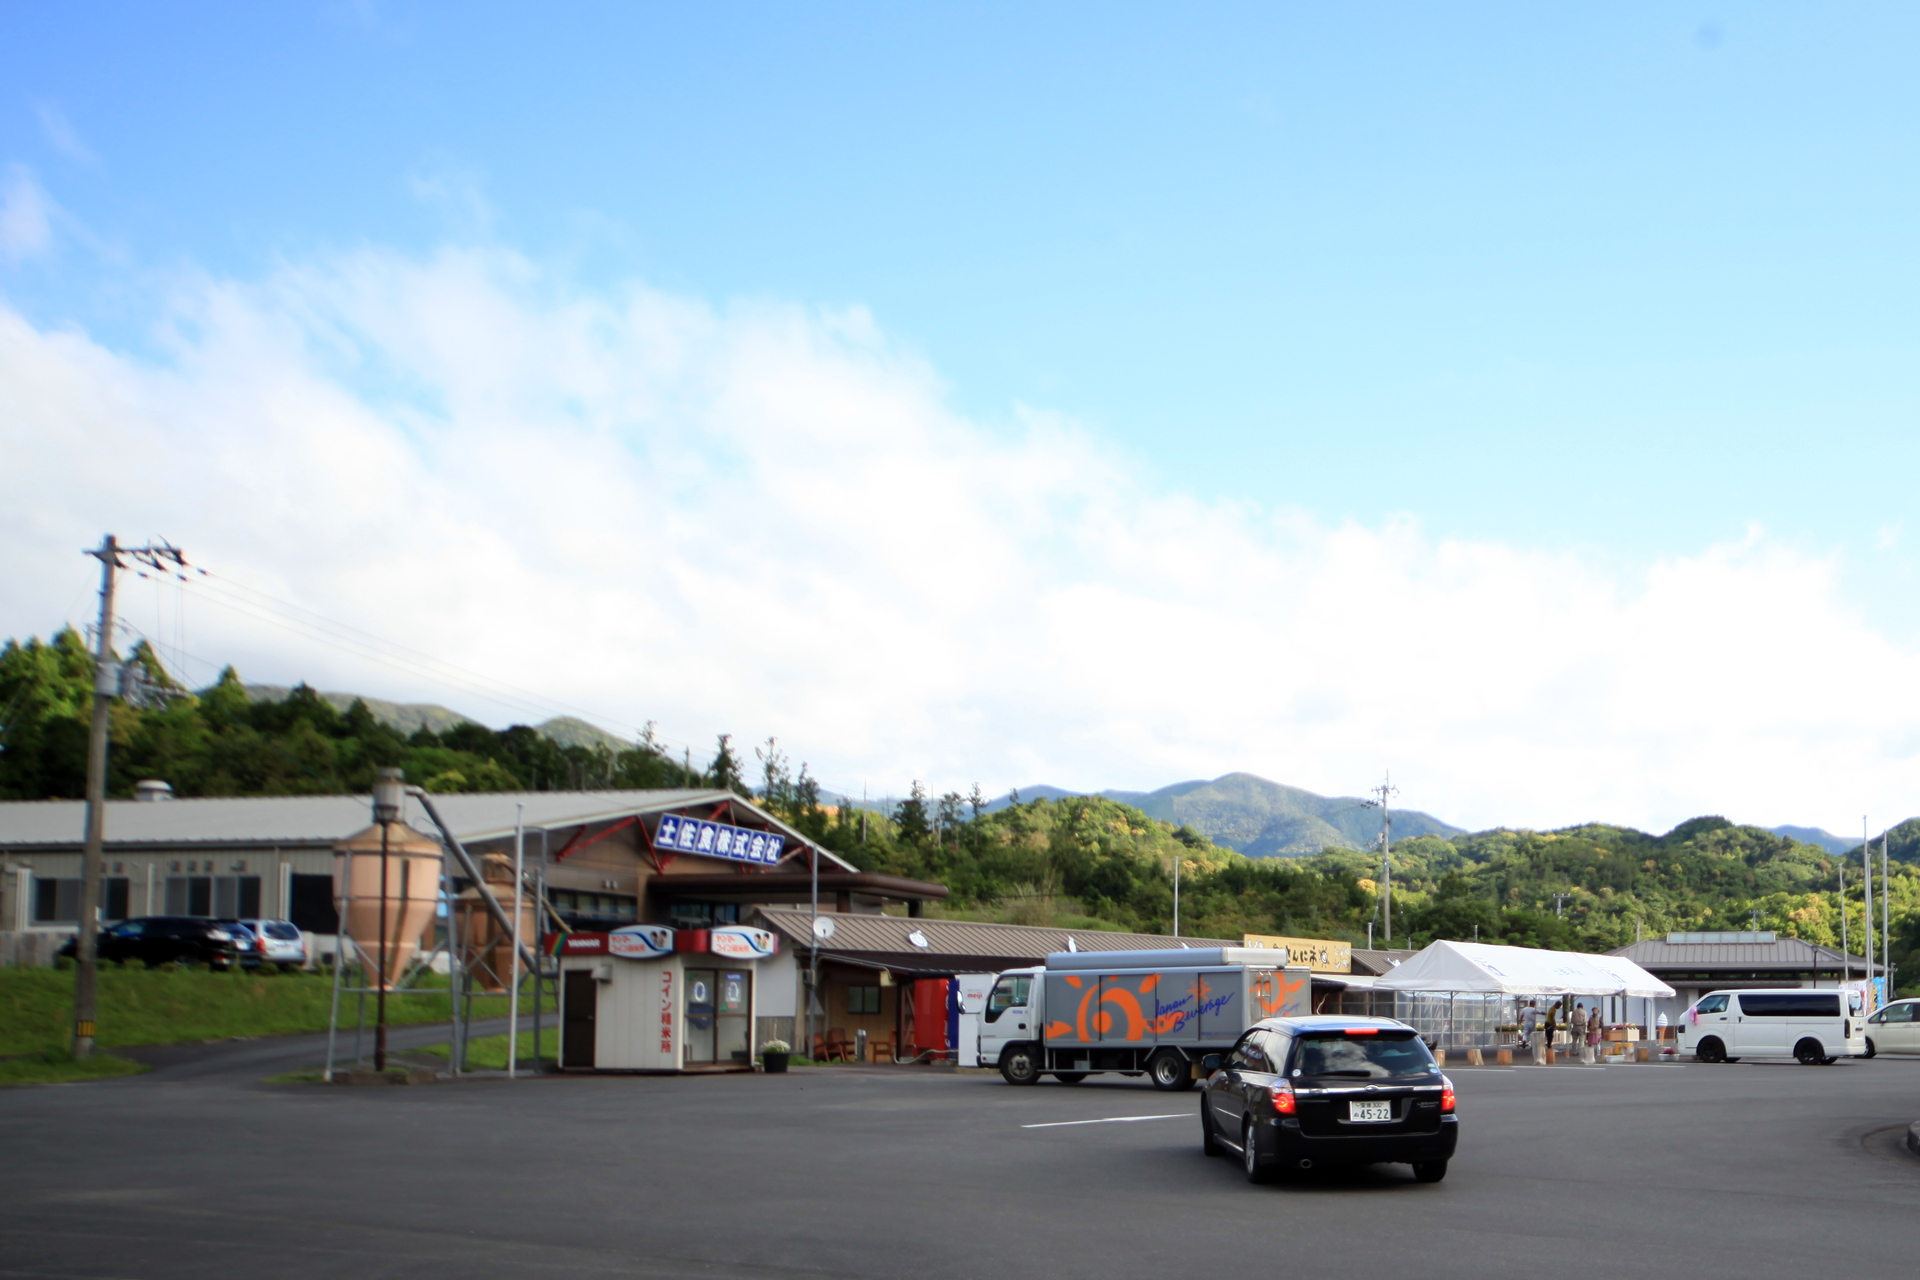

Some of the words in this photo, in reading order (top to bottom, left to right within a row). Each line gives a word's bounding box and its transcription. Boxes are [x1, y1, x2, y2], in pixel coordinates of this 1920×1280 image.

[967, 992, 983, 1000] meiji
[1155, 995, 1193, 1019] Japan
[660, 971, 672, 1054] コイン精米所
[1170, 992, 1235, 1033] Beverage
[1361, 1109, 1389, 1119] 45-22
